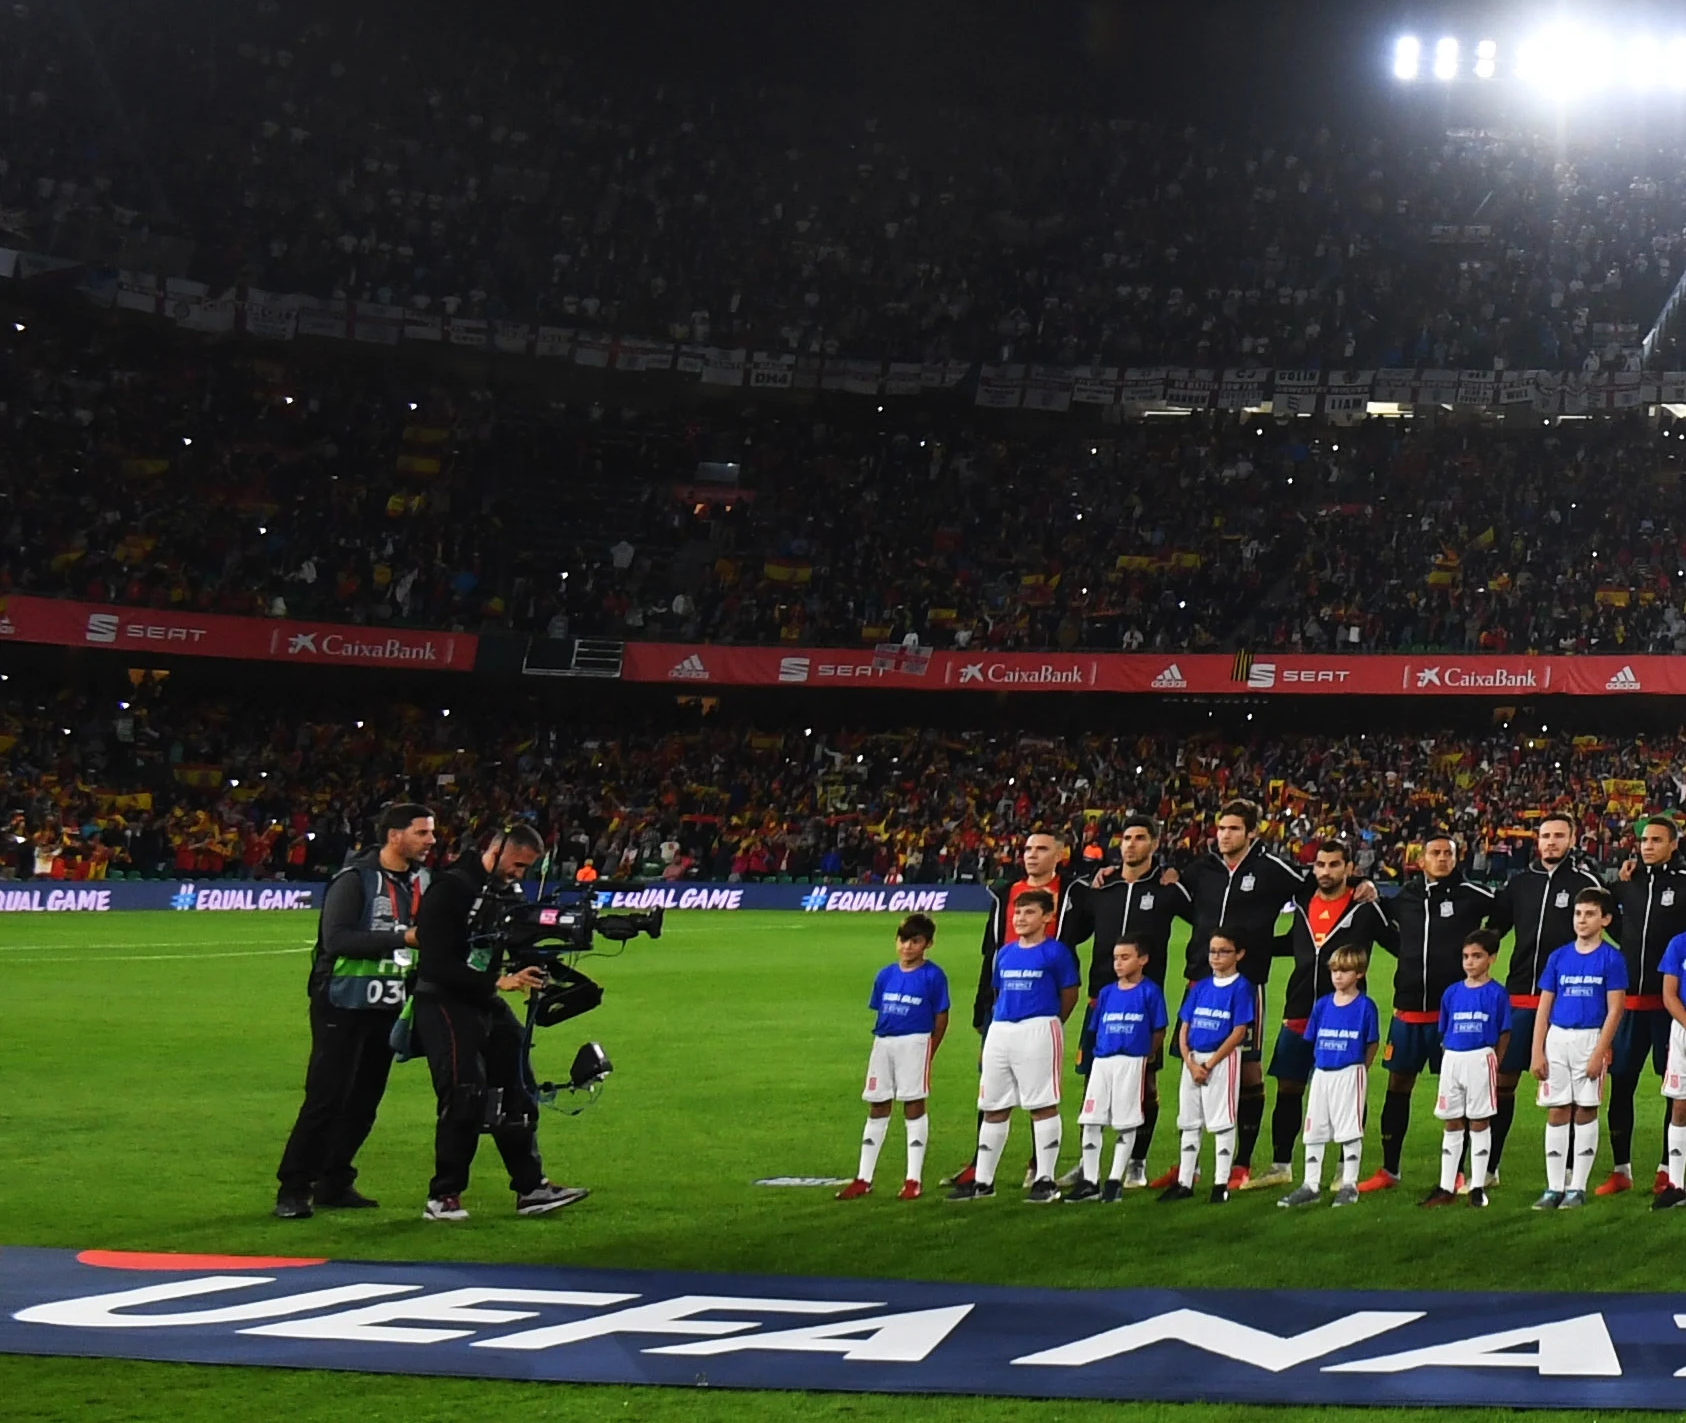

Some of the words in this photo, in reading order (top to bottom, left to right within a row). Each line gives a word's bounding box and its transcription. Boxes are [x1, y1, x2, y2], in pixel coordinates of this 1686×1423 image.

[126, 624, 207, 642] SEAT
[321, 634, 437, 662] CaixaBank
[668, 667, 709, 679] adidas
[987, 664, 1082, 684] CaixaBank
[1151, 675, 1187, 688] adidas
[1283, 670, 1350, 683] SEAT
[1444, 668, 1537, 689] CaixaBank
[1605, 677, 1640, 690] adidas
[47, 890, 111, 911] GAME
[170, 883, 257, 910] #EQUAL
[679, 887, 744, 910] GAME
[802, 885, 890, 911] #EQUAL
[890, 890, 949, 911] GAME
[366, 979, 406, 1004] 03
[14, 1276, 975, 1361] UEFA
